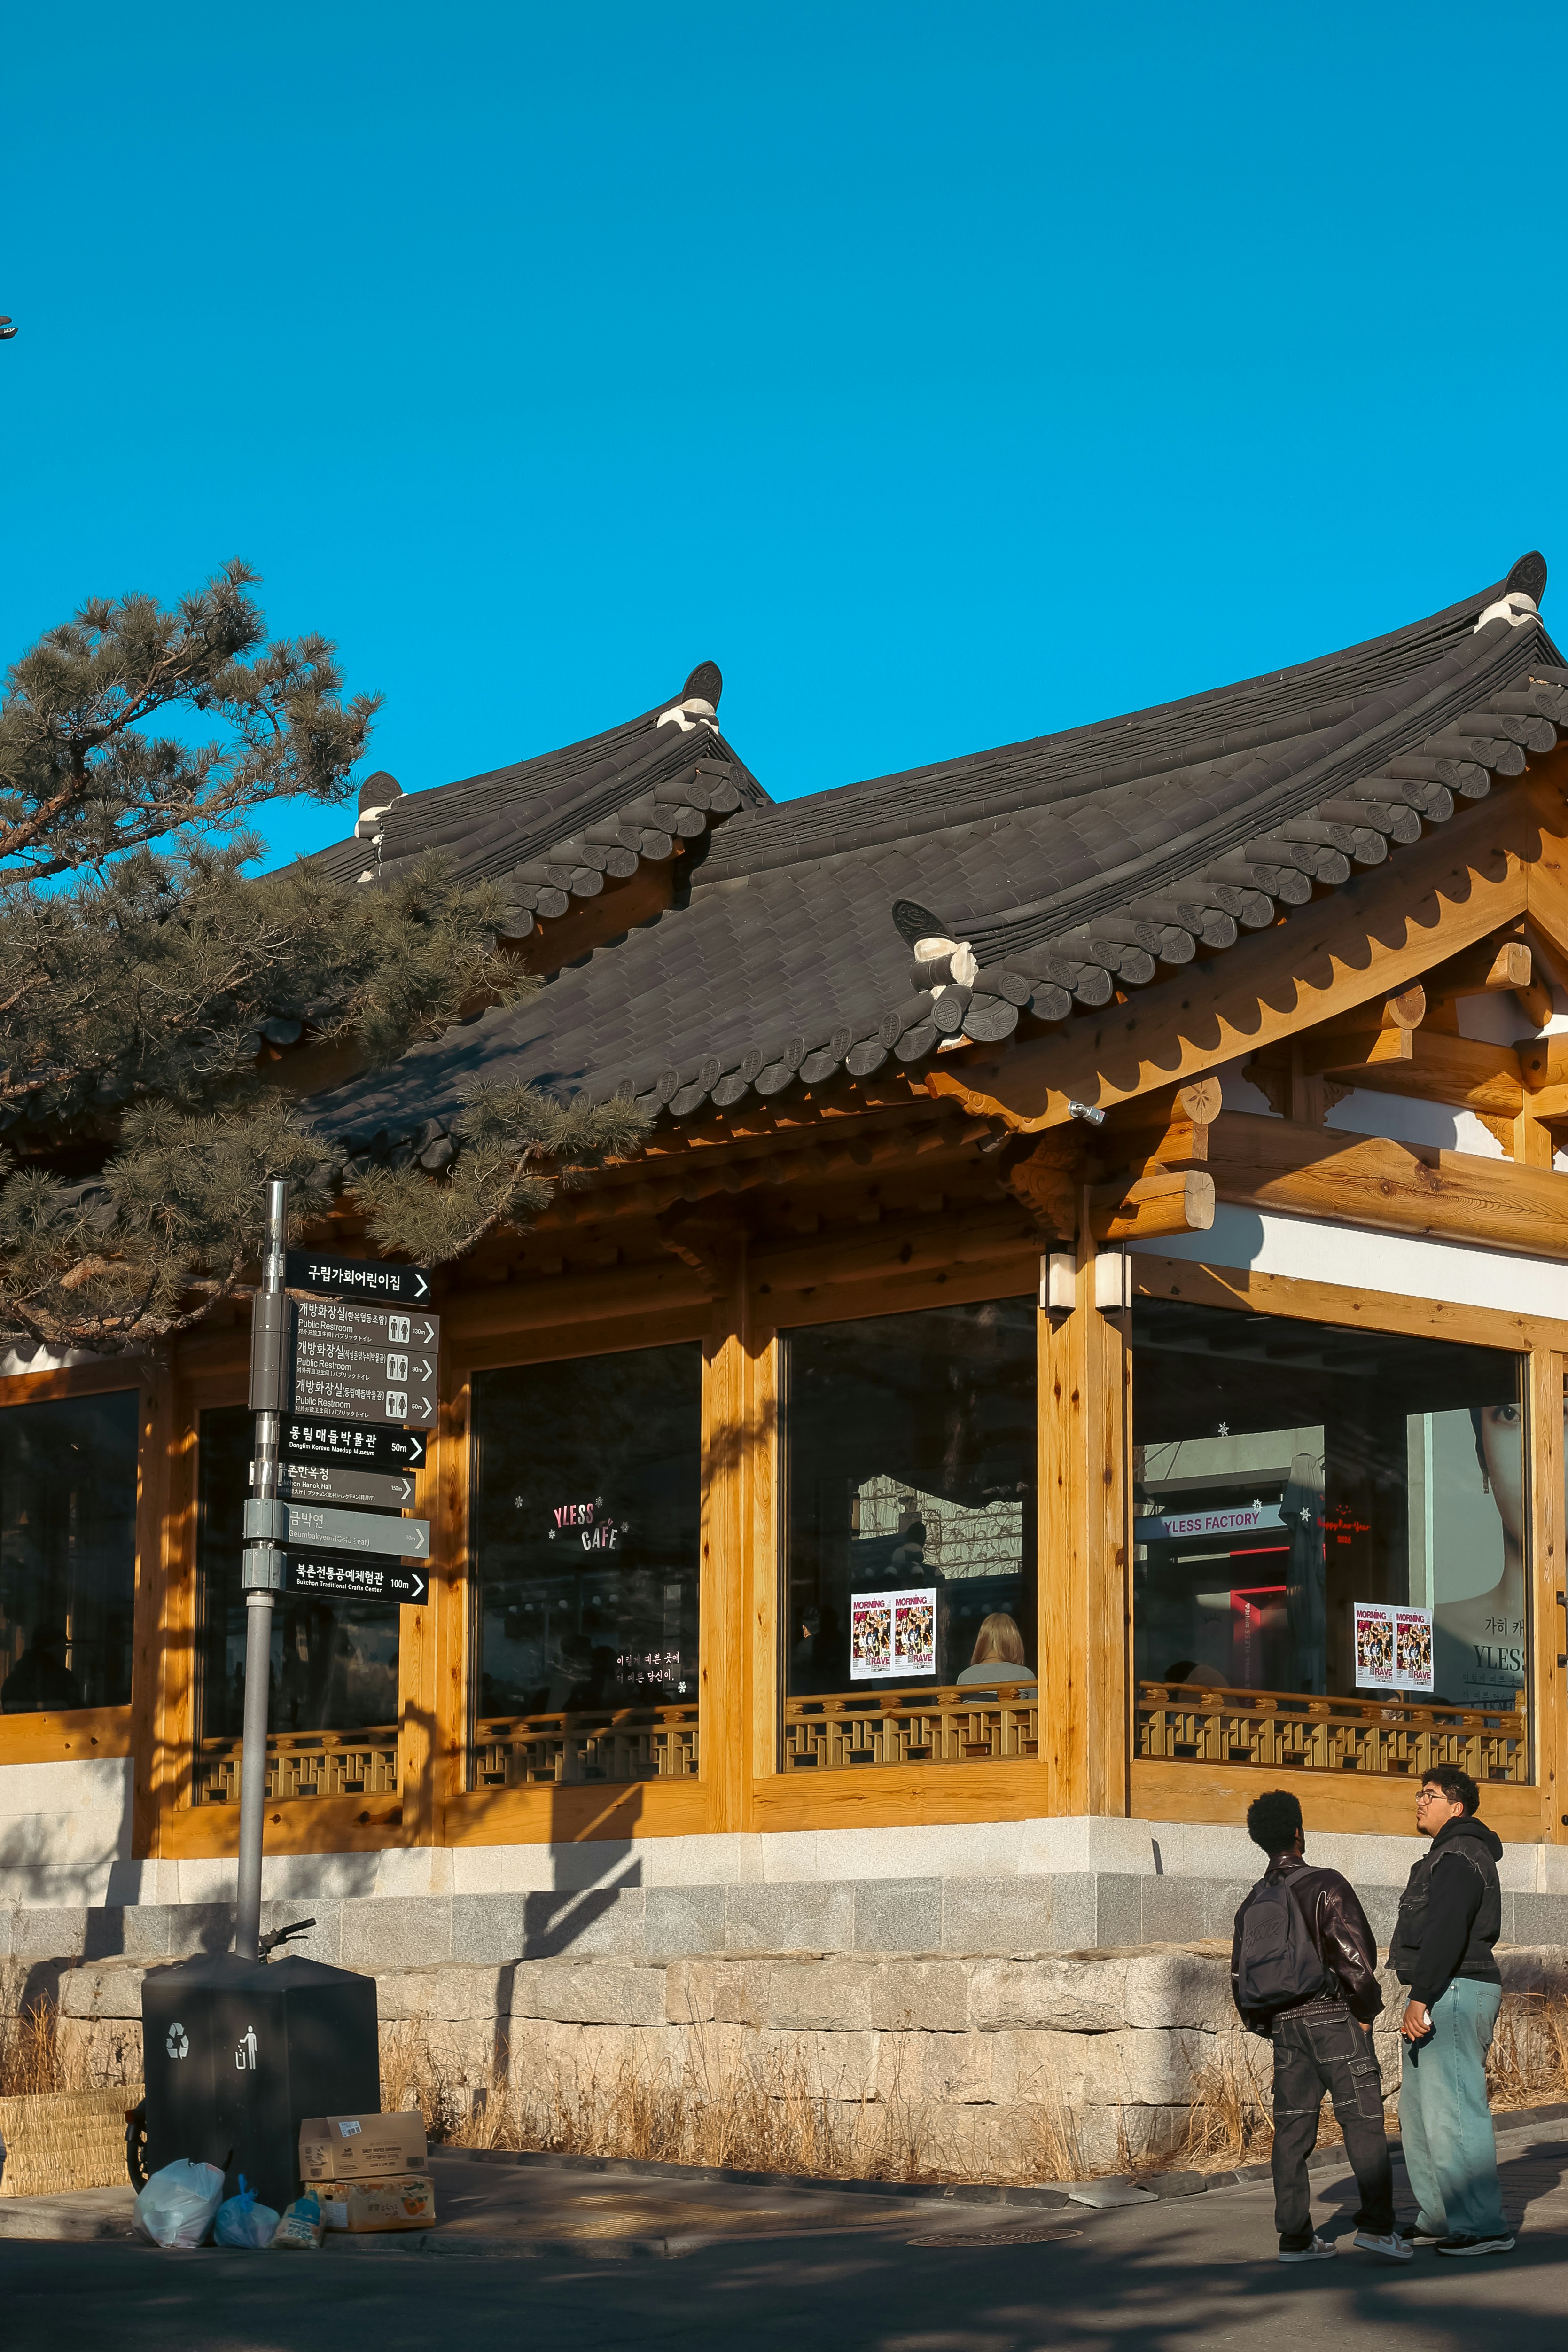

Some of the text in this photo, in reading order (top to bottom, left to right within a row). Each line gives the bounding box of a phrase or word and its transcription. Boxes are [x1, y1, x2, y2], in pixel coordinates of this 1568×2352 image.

[308, 1265, 400, 1291] 구립가회어린이집
[299, 1302, 387, 1326] 개방화장실(한옥협동조합)
[298, 1319, 353, 1333] Public Restroom
[296, 1357, 351, 1371] Public Restroom
[295, 1395, 350, 1409] Public Restroom
[289, 1441, 311, 1450] Donglim
[391, 1443, 407, 1453] 50m
[302, 1481, 320, 1489] Hanok
[289, 1511, 323, 1529] 금박연
[554, 1503, 594, 1528] YLESS
[1164, 1512, 1260, 1533] YLESS FACTORY
[1337, 1535, 1351, 1544] 2026
[296, 1564, 384, 1585] 북촌전통공예체험관
[390, 1579, 409, 1589] 100m
[853, 1599, 885, 1610] MORNING
[895, 1596, 928, 1606] MORNING
[1357, 1610, 1387, 1620] MORNING
[1396, 1613, 1425, 1623] MORNING
[1485, 1617, 1508, 1637] 가히
[617, 1651, 679, 1667] 이렇게 예쁜 곳에
[871, 1656, 890, 1665] RAVE
[913, 1653, 933, 1663] RAVE
[1375, 1667, 1393, 1677] RAVE
[1413, 1670, 1431, 1679] RAVE
[616, 1673, 623, 1684] 더
[627, 1672, 645, 1683] 예쁜
